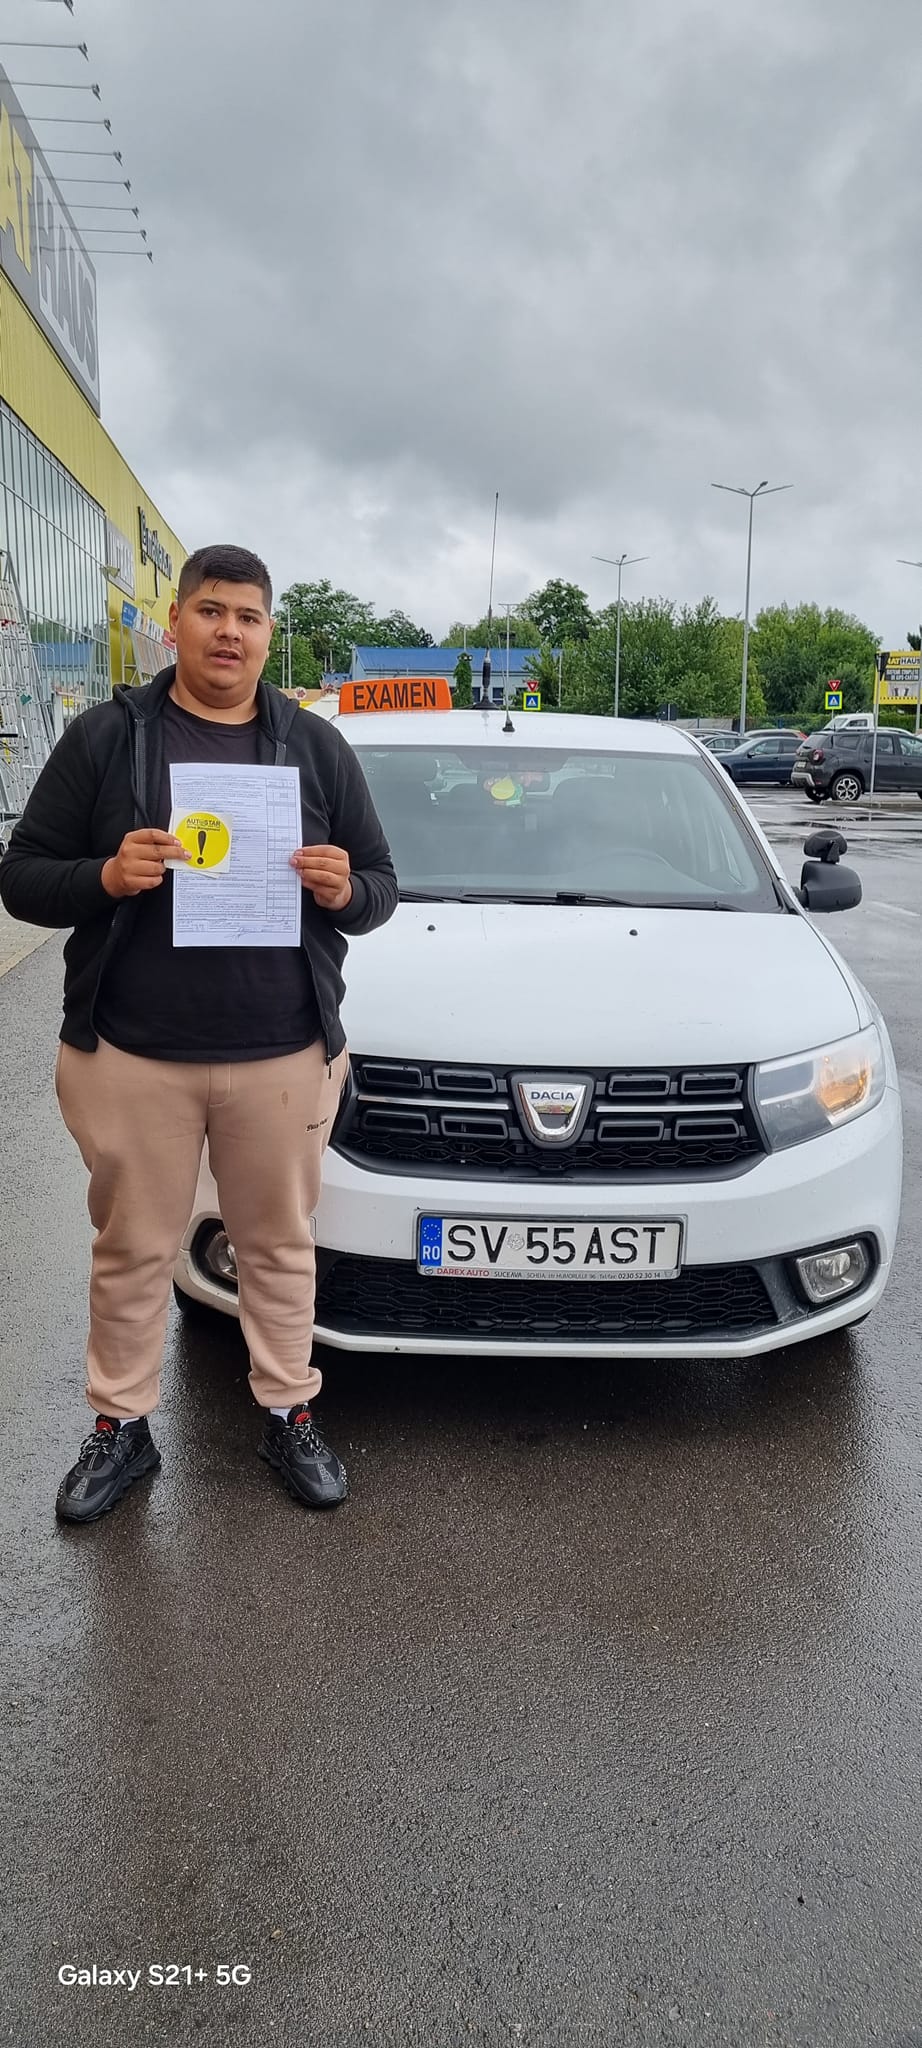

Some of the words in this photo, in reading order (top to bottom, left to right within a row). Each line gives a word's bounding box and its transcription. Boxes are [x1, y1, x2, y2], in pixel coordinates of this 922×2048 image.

[353, 682, 436, 710] EXAMEN
[531, 1091, 575, 1100] DACIA
[448, 1225, 508, 1263] SV
[526, 1227, 576, 1264] 55
[583, 1227, 666, 1264] AST
[423, 1245, 440, 1260] RO
[437, 1268, 465, 1276] DAREX
[467, 1269, 490, 1277] AUTO
